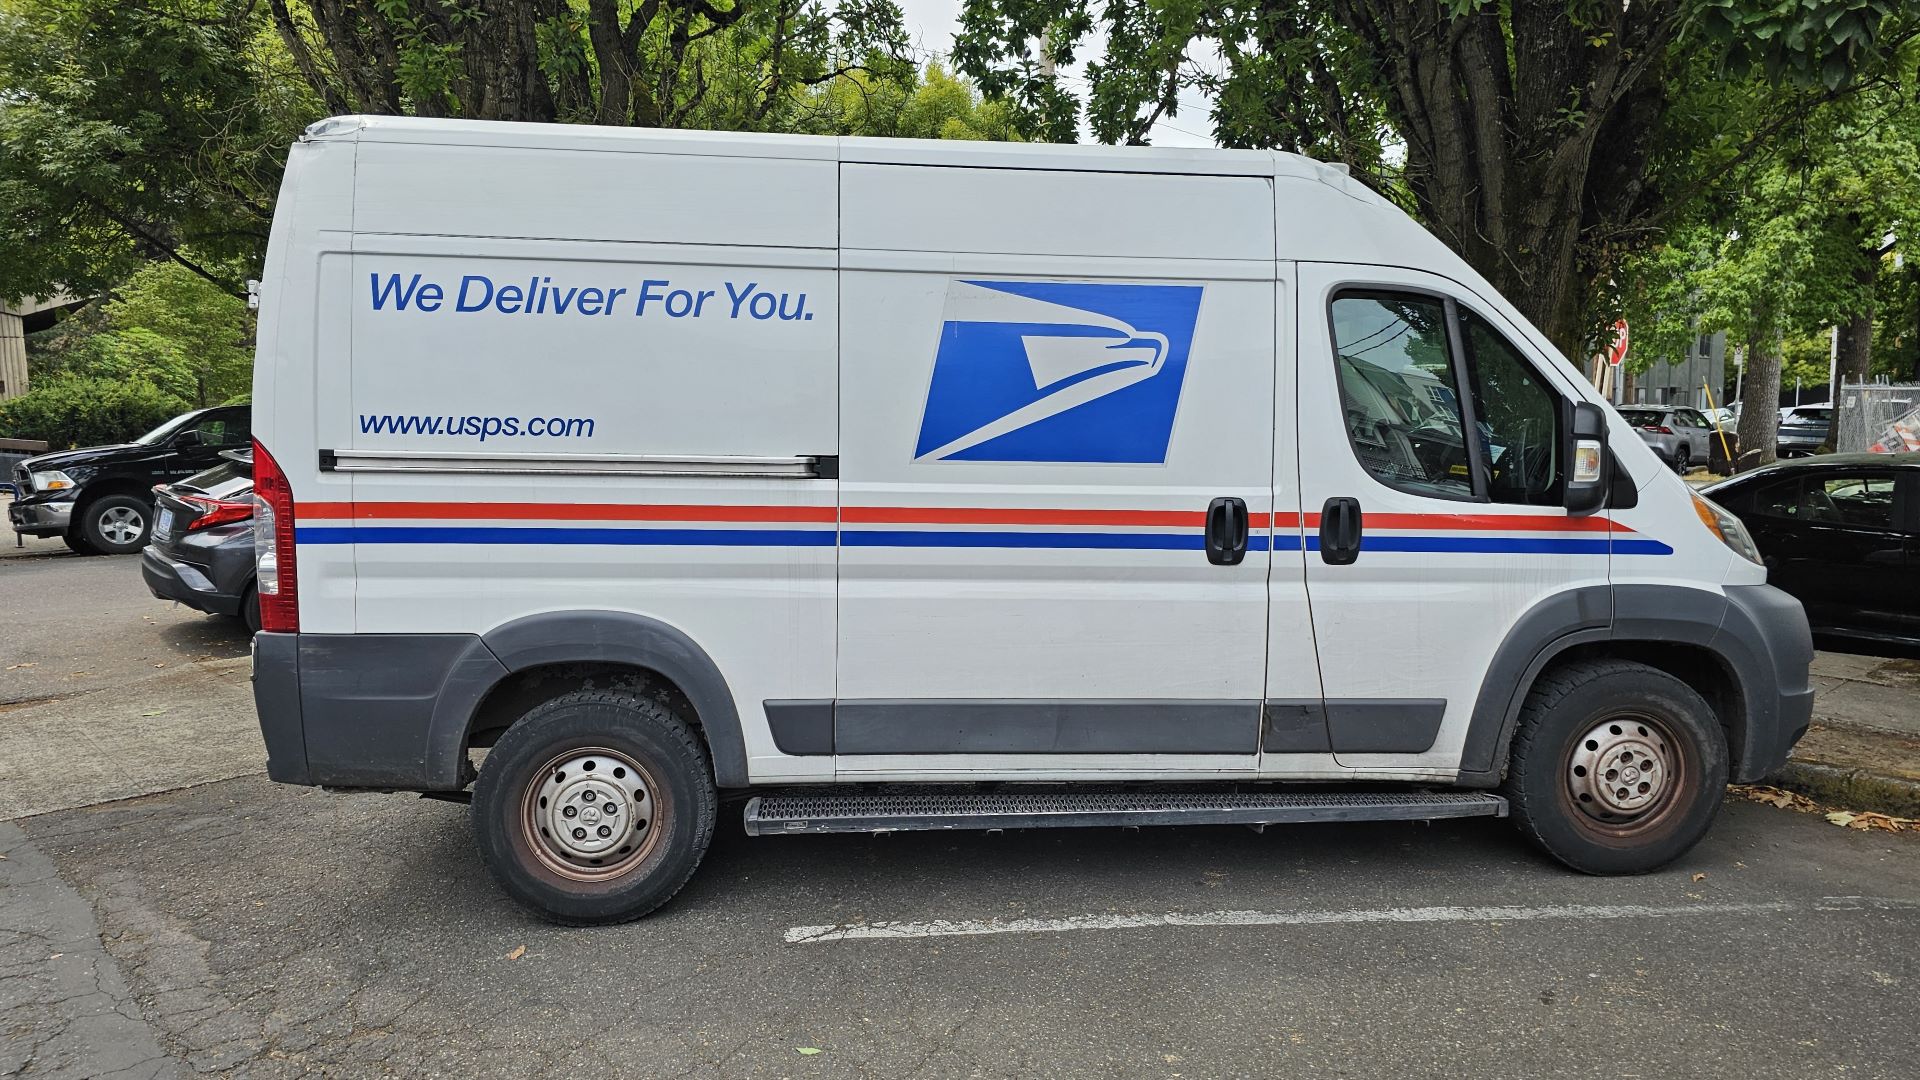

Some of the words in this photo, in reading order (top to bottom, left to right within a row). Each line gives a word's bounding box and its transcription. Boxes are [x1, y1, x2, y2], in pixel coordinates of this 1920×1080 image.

[370, 272, 444, 312] We
[455, 275, 626, 316] Deliver
[635, 279, 716, 318] For
[725, 281, 814, 321] You.
[359, 414, 595, 442] www.usps.com
